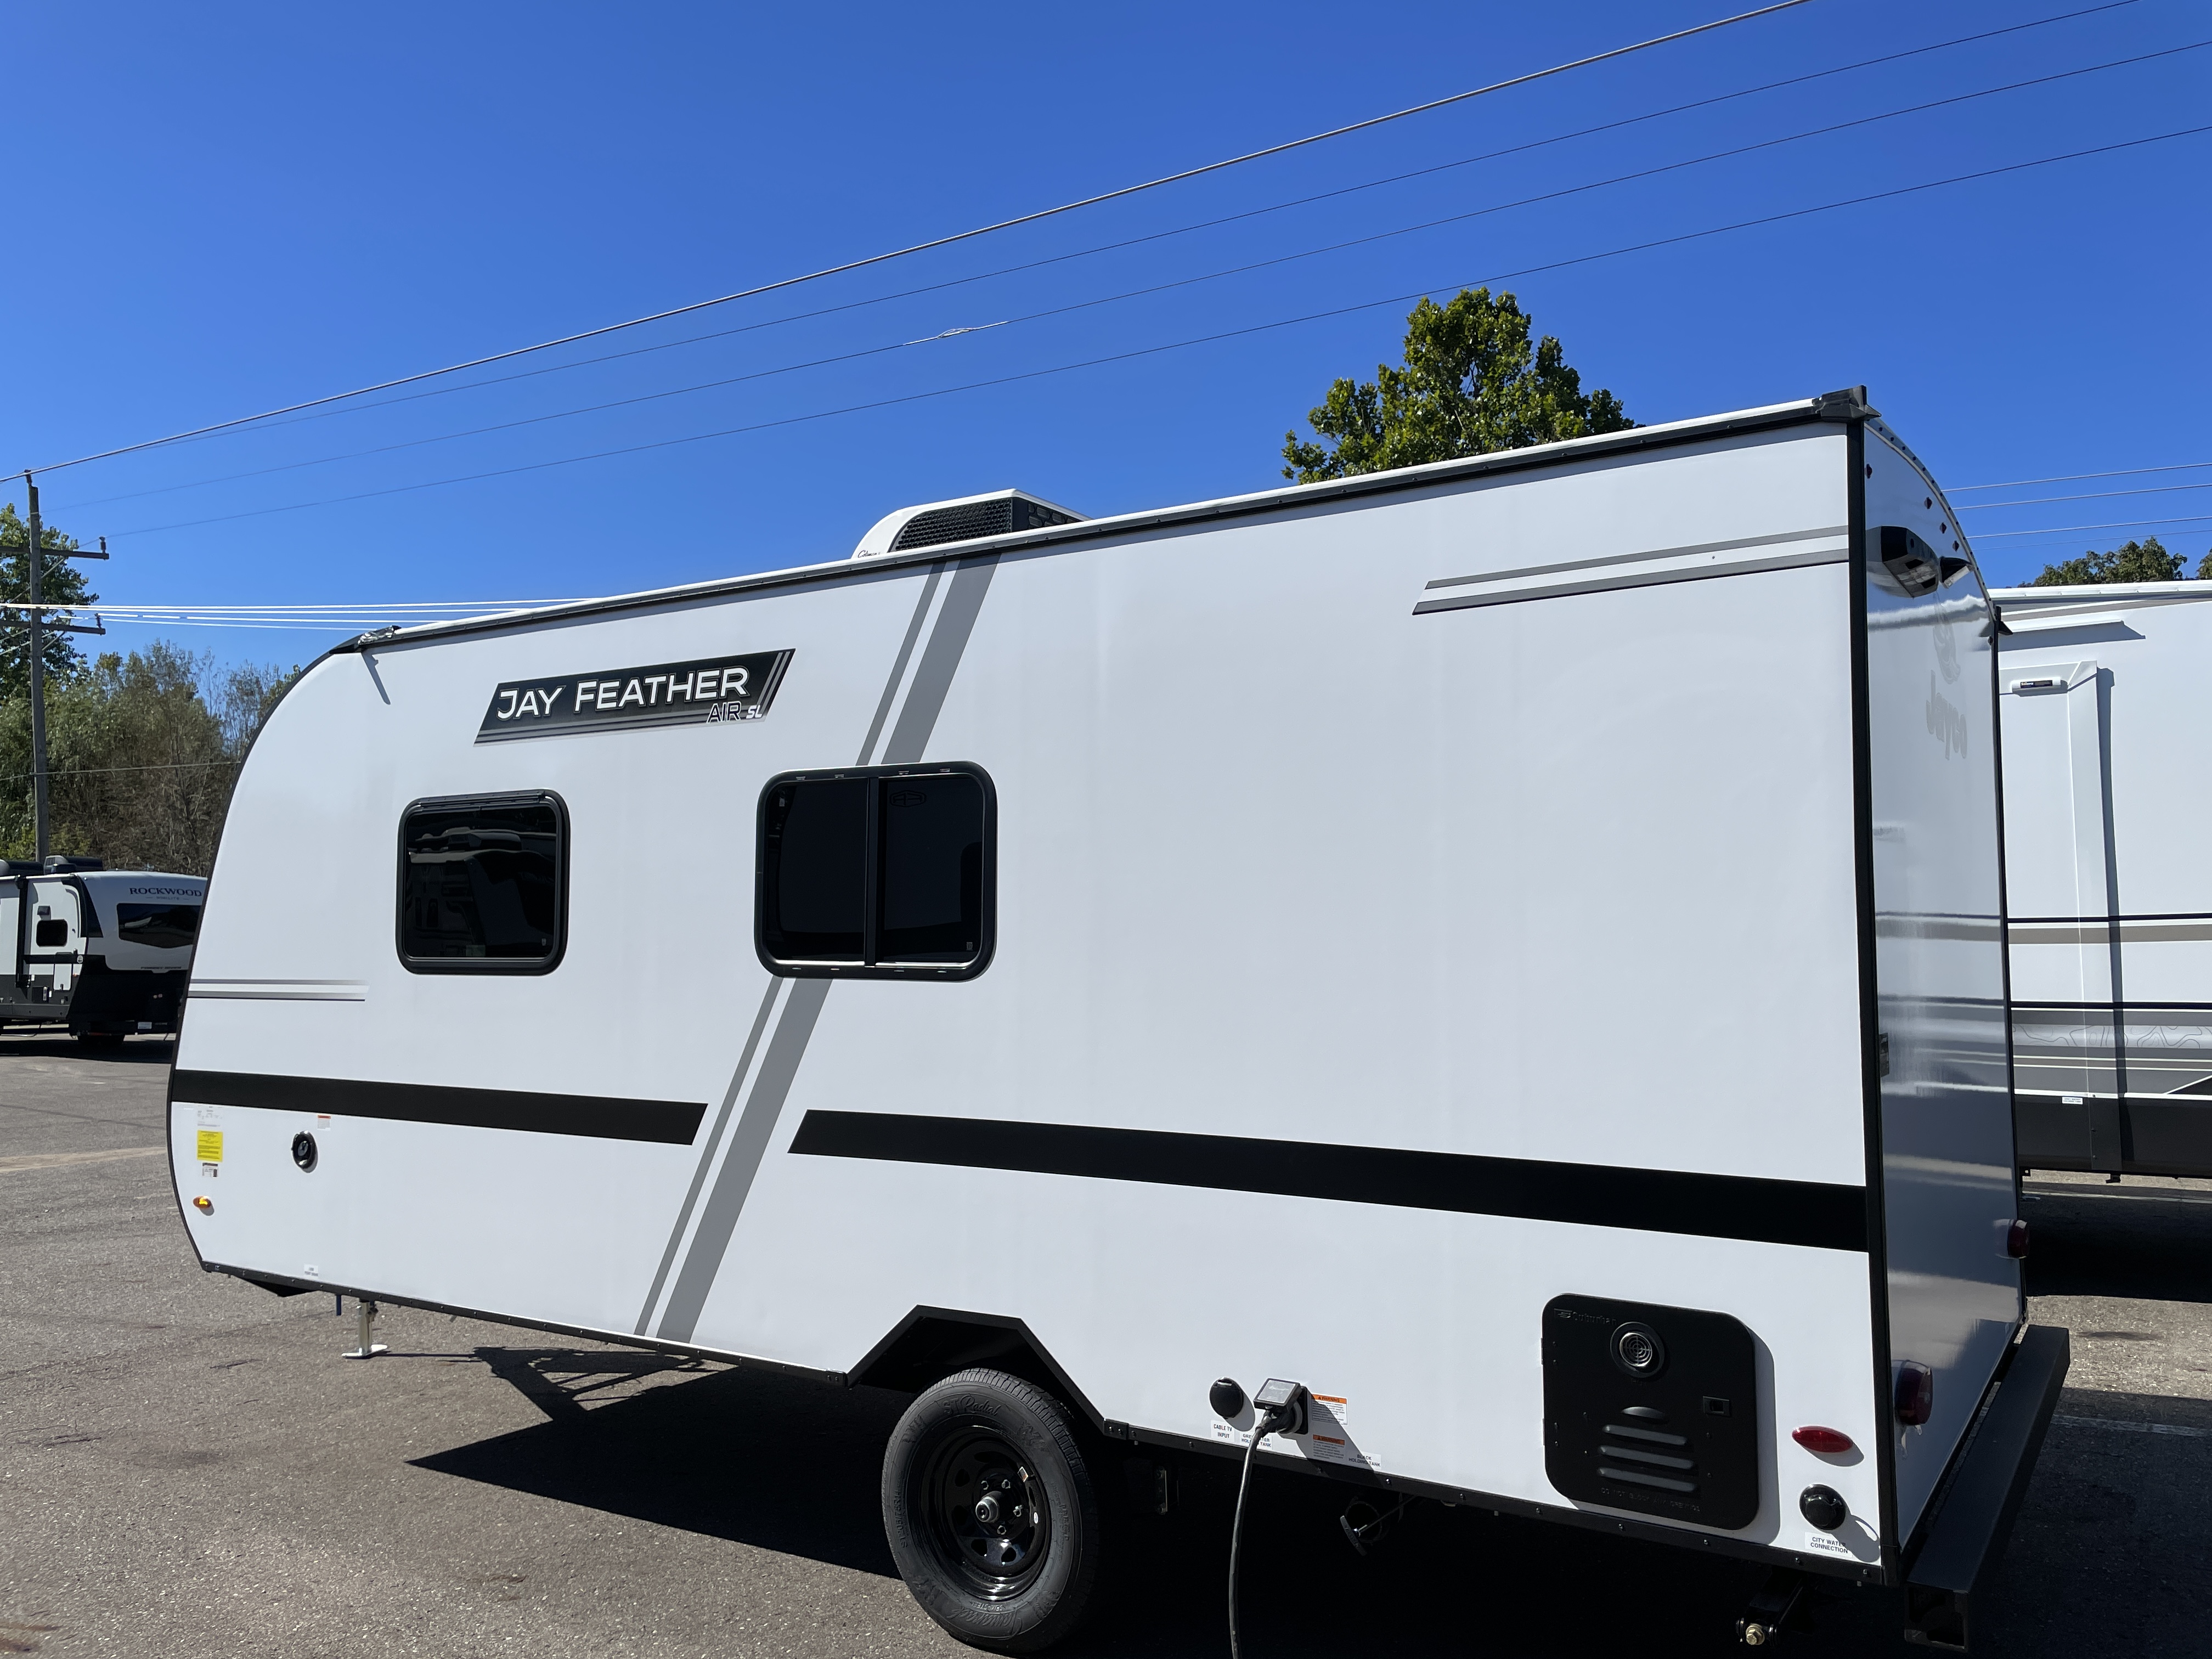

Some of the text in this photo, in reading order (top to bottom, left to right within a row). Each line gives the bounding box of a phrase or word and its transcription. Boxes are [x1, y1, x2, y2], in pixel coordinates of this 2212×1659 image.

[496, 667, 749, 719] JAY FEATHER
[706, 701, 763, 723] AIR SL
[129, 887, 202, 897] ROCKWOOD
[960, 1394, 1002, 1416] Radial
[1810, 1542, 1848, 1554] CONNECTION
[1826, 1539, 1846, 1547] WATER
